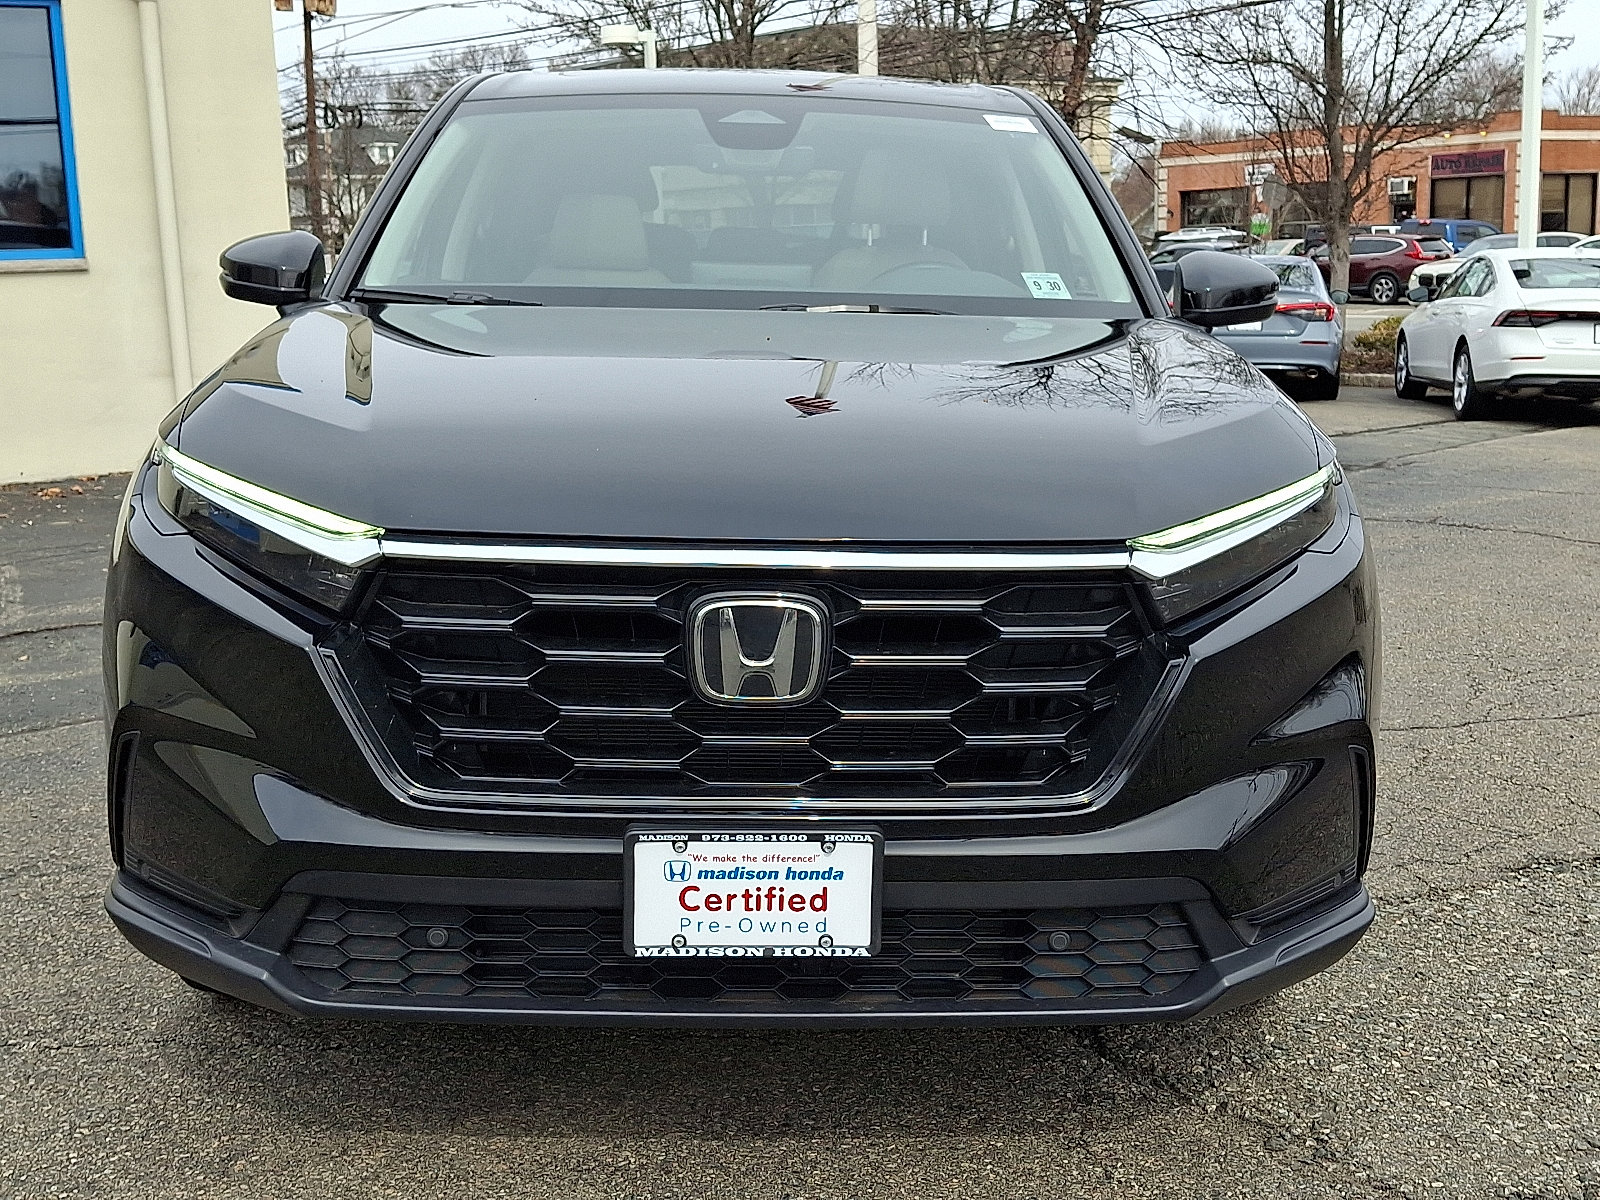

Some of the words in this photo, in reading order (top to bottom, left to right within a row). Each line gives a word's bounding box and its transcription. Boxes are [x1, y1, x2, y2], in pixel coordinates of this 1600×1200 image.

[1432, 158, 1461, 170] AUTO
[1033, 280, 1042, 291] 9
[1046, 280, 1061, 291] 30
[638, 834, 689, 842] MADISON
[701, 834, 808, 842] 973-822-1600
[824, 834, 875, 843] HONDA
[712, 853, 737, 862] make
[741, 854, 758, 862] the
[697, 866, 779, 880] madison
[785, 866, 844, 880] honda
[678, 885, 828, 912] Certified
[680, 917, 828, 933] Pre-Owned
[634, 947, 765, 957] MADISON
[773, 947, 871, 957] HONDA
